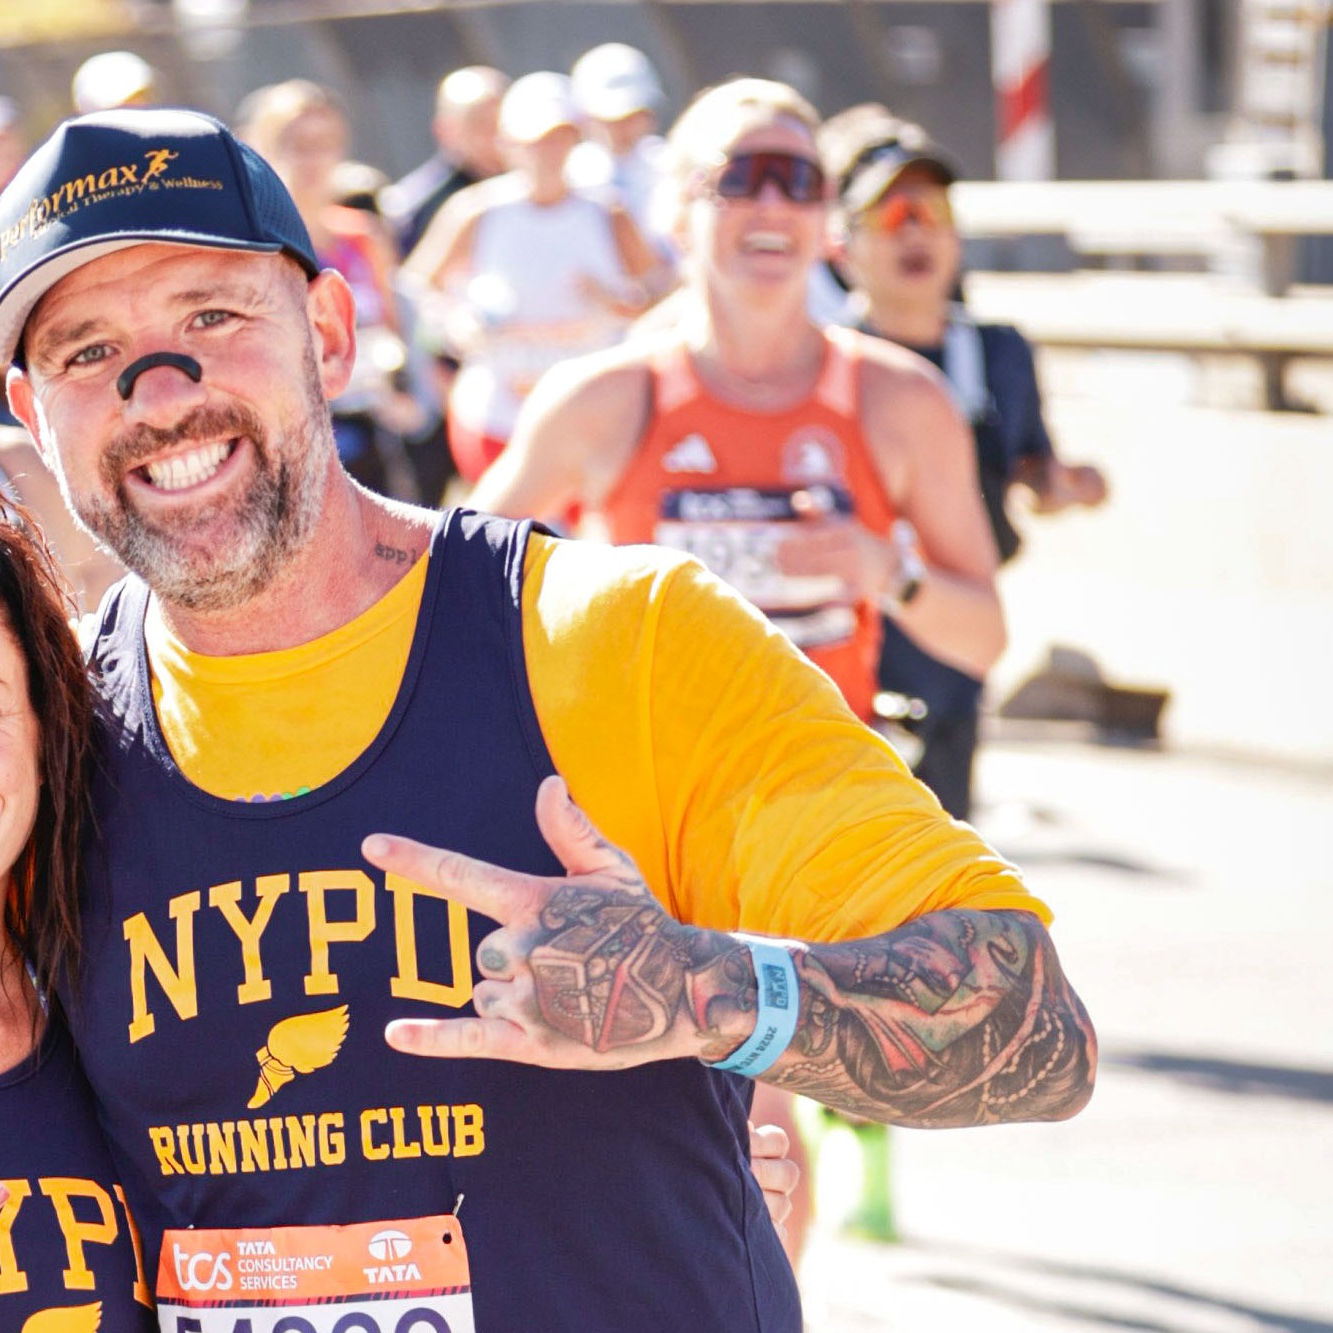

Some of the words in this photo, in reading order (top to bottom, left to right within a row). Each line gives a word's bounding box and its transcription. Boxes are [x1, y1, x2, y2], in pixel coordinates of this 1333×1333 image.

[162, 176, 224, 191] Wellness
[123, 869, 474, 1044] NYPD
[148, 1112, 346, 1176] RUNNING
[360, 1103, 486, 1161] CLUB
[173, 1242, 234, 1291] tcs
[237, 1240, 276, 1256] TATA
[237, 1255, 334, 1274] CONSULTANCY
[363, 1263, 422, 1285] TATA
[240, 1275, 298, 1290] SERVICES
